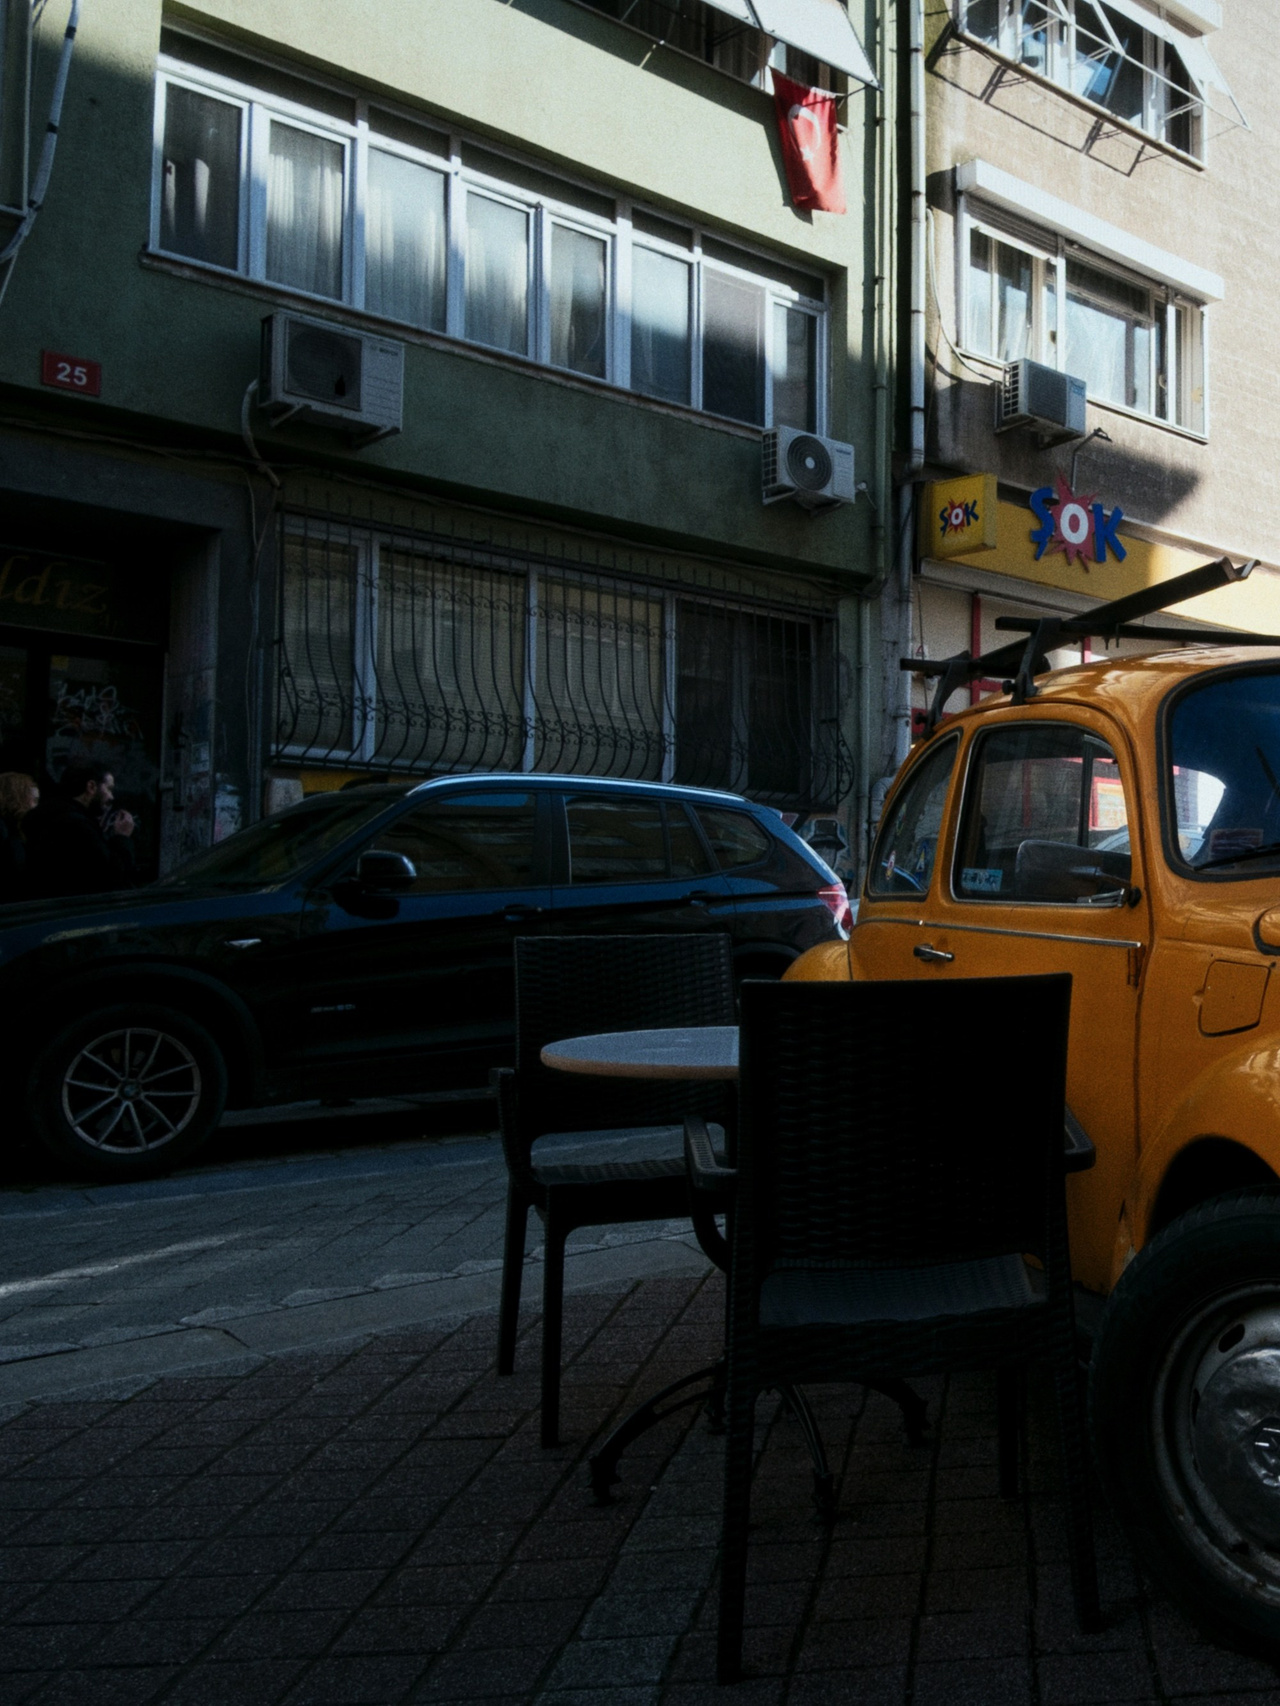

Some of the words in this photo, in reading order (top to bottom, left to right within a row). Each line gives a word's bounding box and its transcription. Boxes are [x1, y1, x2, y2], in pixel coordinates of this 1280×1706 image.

[56, 362, 88, 386] 25
[939, 498, 980, 538] ŞOK
[1029, 486, 1128, 563] ŞOK
